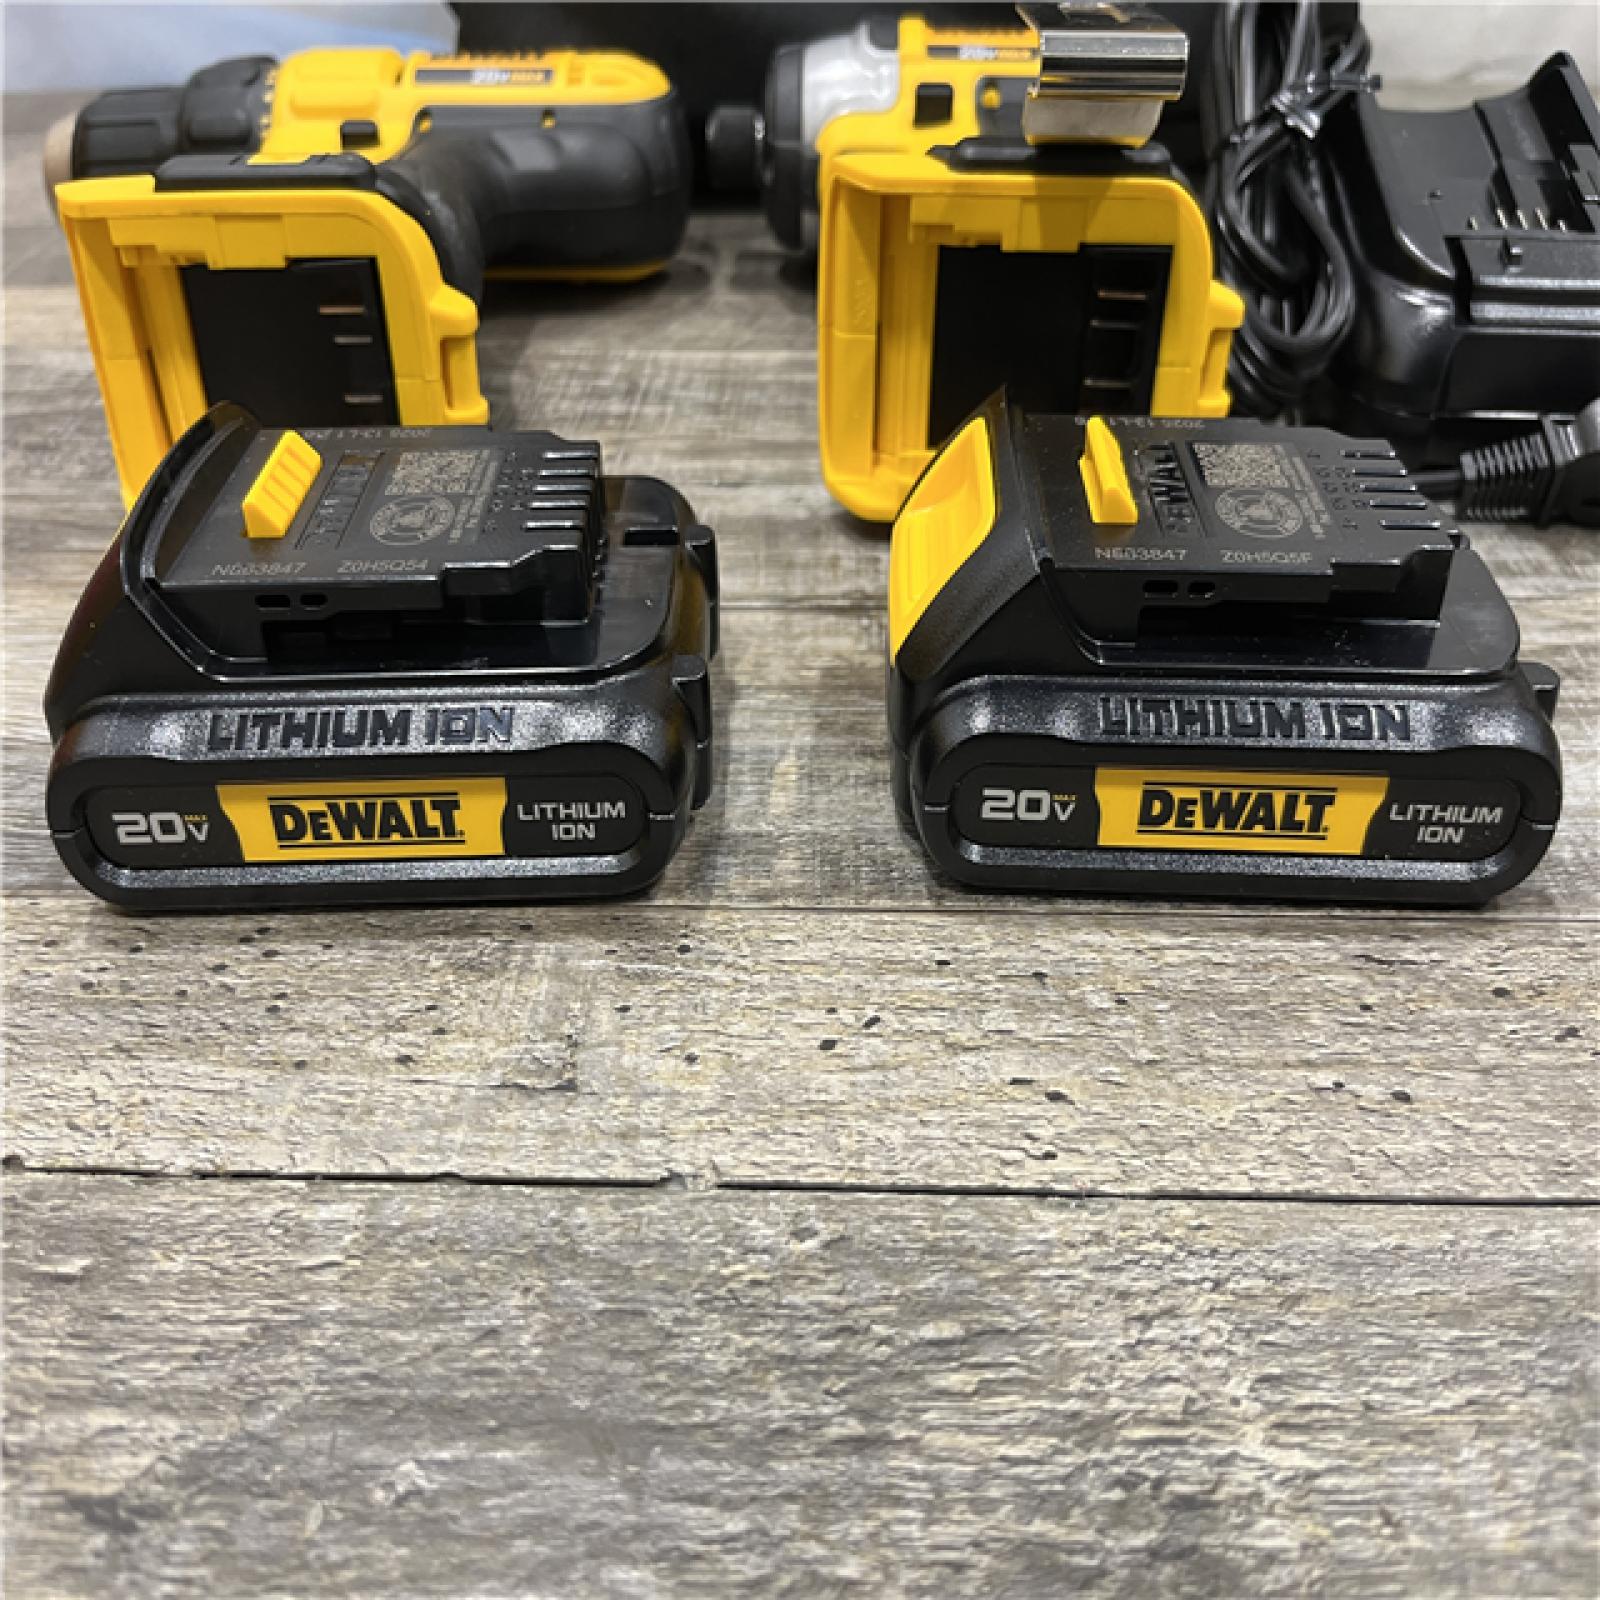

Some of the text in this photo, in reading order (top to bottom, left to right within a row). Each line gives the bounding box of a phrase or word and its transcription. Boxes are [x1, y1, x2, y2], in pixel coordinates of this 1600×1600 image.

[207, 706, 514, 750] LITHIUM ION
[1099, 697, 1411, 742] LITHIUM ION
[270, 799, 465, 841] DEWALT
[517, 802, 626, 821] LITHIUM
[1138, 789, 1336, 833] DEWALT
[1389, 804, 1503, 824] LITHIUM
[552, 823, 596, 841] ION
[1416, 826, 1464, 844] ION
